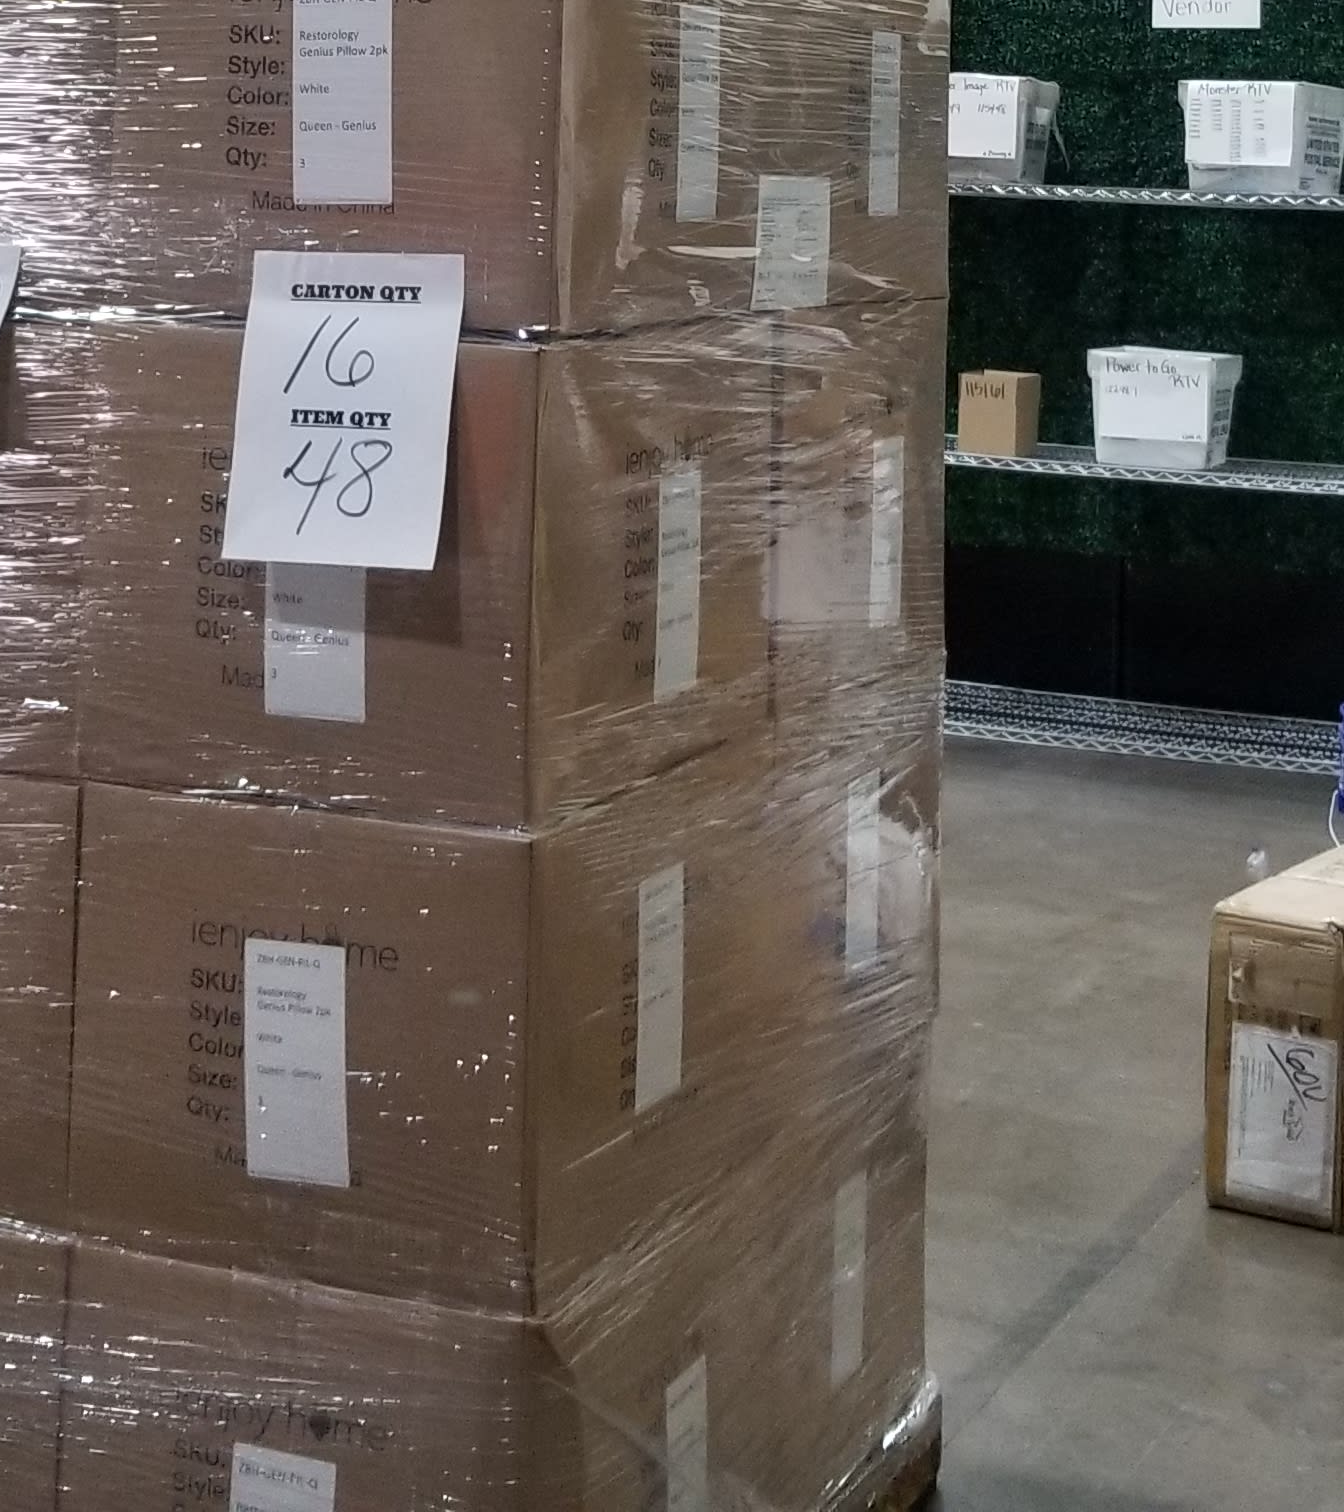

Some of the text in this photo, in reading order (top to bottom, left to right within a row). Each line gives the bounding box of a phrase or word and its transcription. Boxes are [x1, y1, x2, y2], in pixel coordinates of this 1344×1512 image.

[229, 25, 281, 45] SKU:
[299, 30, 359, 42] Restorology
[299, 45, 389, 58] Genius Pillow 2pk
[227, 56, 286, 79] Style:
[227, 85, 290, 106] Color:
[299, 83, 330, 94] White
[1198, 83, 1241, 96] Monster
[226, 116, 277, 136] Size:
[299, 120, 377, 133] Queen Genius
[226, 147, 268, 170] Qty:
[291, 284, 422, 302] CARTON QTY
[283, 315, 375, 393] 16
[1106, 356, 1140, 373] Power
[1170, 374, 1201, 388] RTV
[291, 409, 392, 428] ITEM QTY
[283, 437, 393, 535] 48
[197, 557, 266, 579] Color:
[197, 588, 246, 609] Size:
[272, 593, 303, 604] White
[196, 619, 237, 644] Qty:
[272, 630, 303, 643] Queen
[222, 665, 264, 688] Mad
[191, 968, 243, 993] SKU:
[188, 1064, 237, 1089] Size:
[186, 1096, 230, 1121] Qty:
